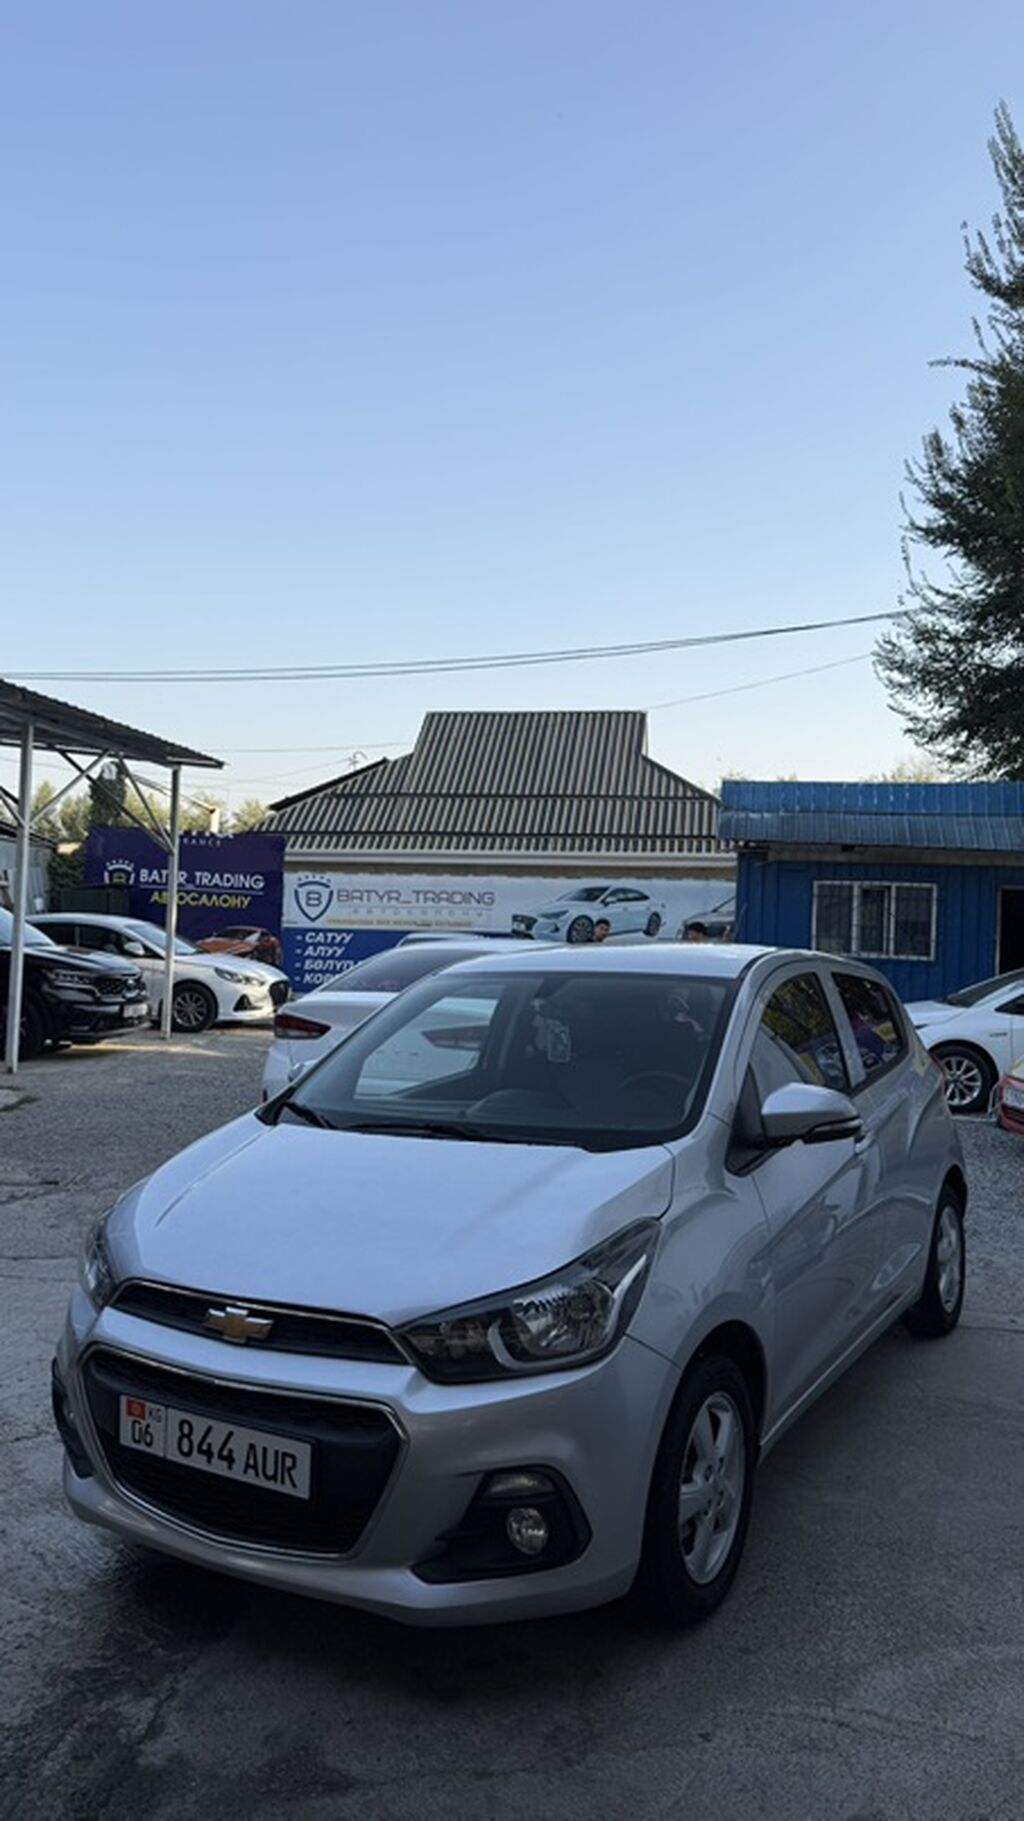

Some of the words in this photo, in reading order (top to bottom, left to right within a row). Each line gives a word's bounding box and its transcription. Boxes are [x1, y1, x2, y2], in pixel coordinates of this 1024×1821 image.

[150, 891, 251, 909] АВОСАЛОНУ
[131, 1419, 154, 1447] 06
[177, 1418, 236, 1471] 844
[243, 1442, 298, 1489] AUR
